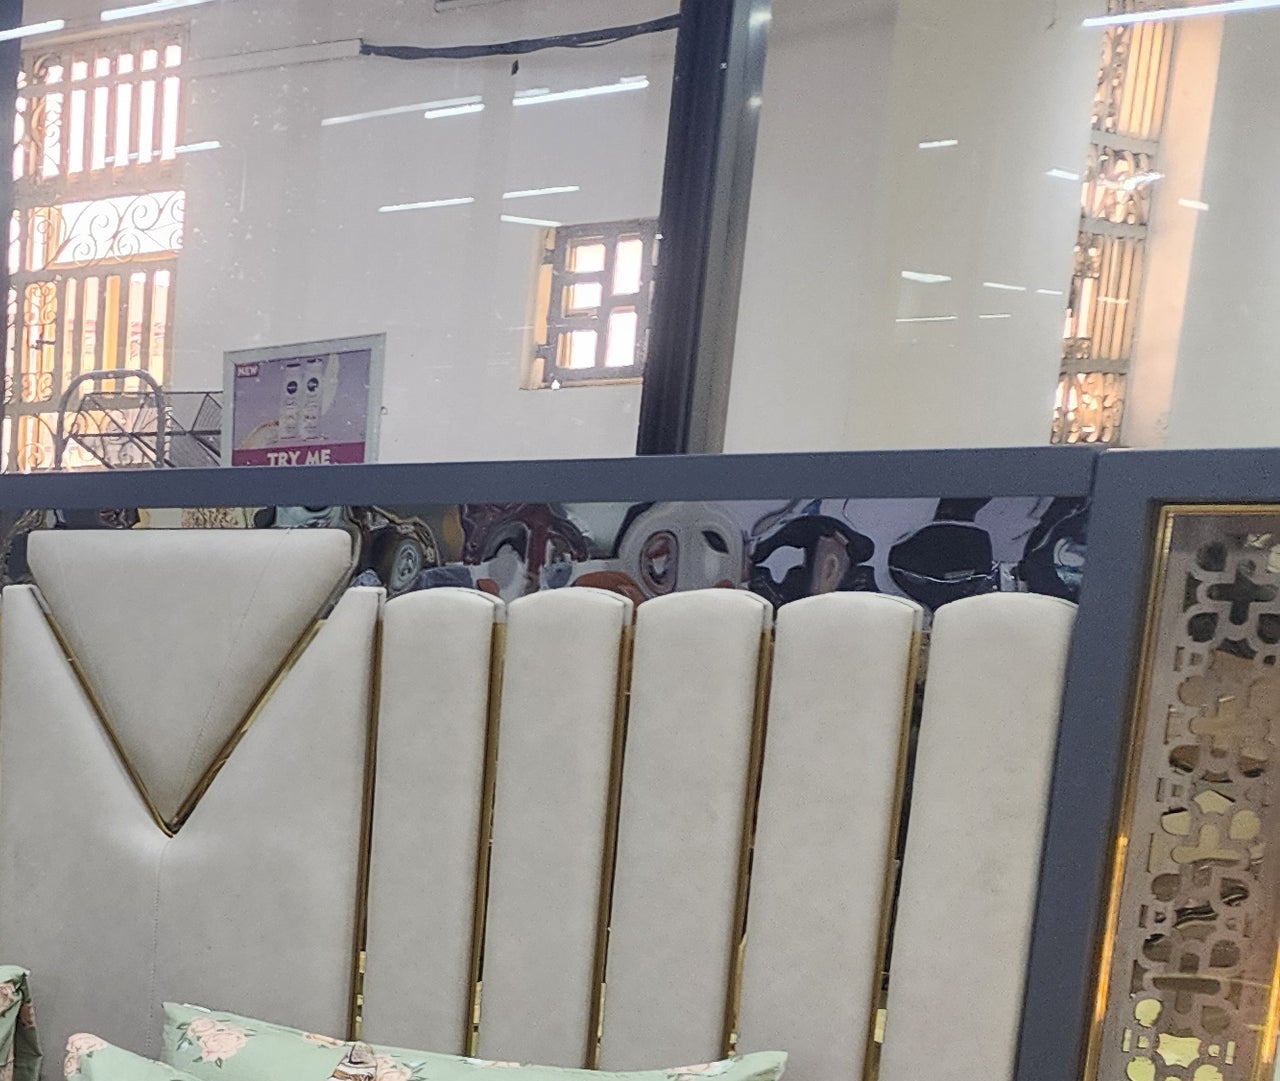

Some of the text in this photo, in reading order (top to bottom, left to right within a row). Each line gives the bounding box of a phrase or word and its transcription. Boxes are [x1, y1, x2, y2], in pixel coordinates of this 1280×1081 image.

[238, 364, 258, 376] NEW
[267, 448, 331, 466] TRY ME
